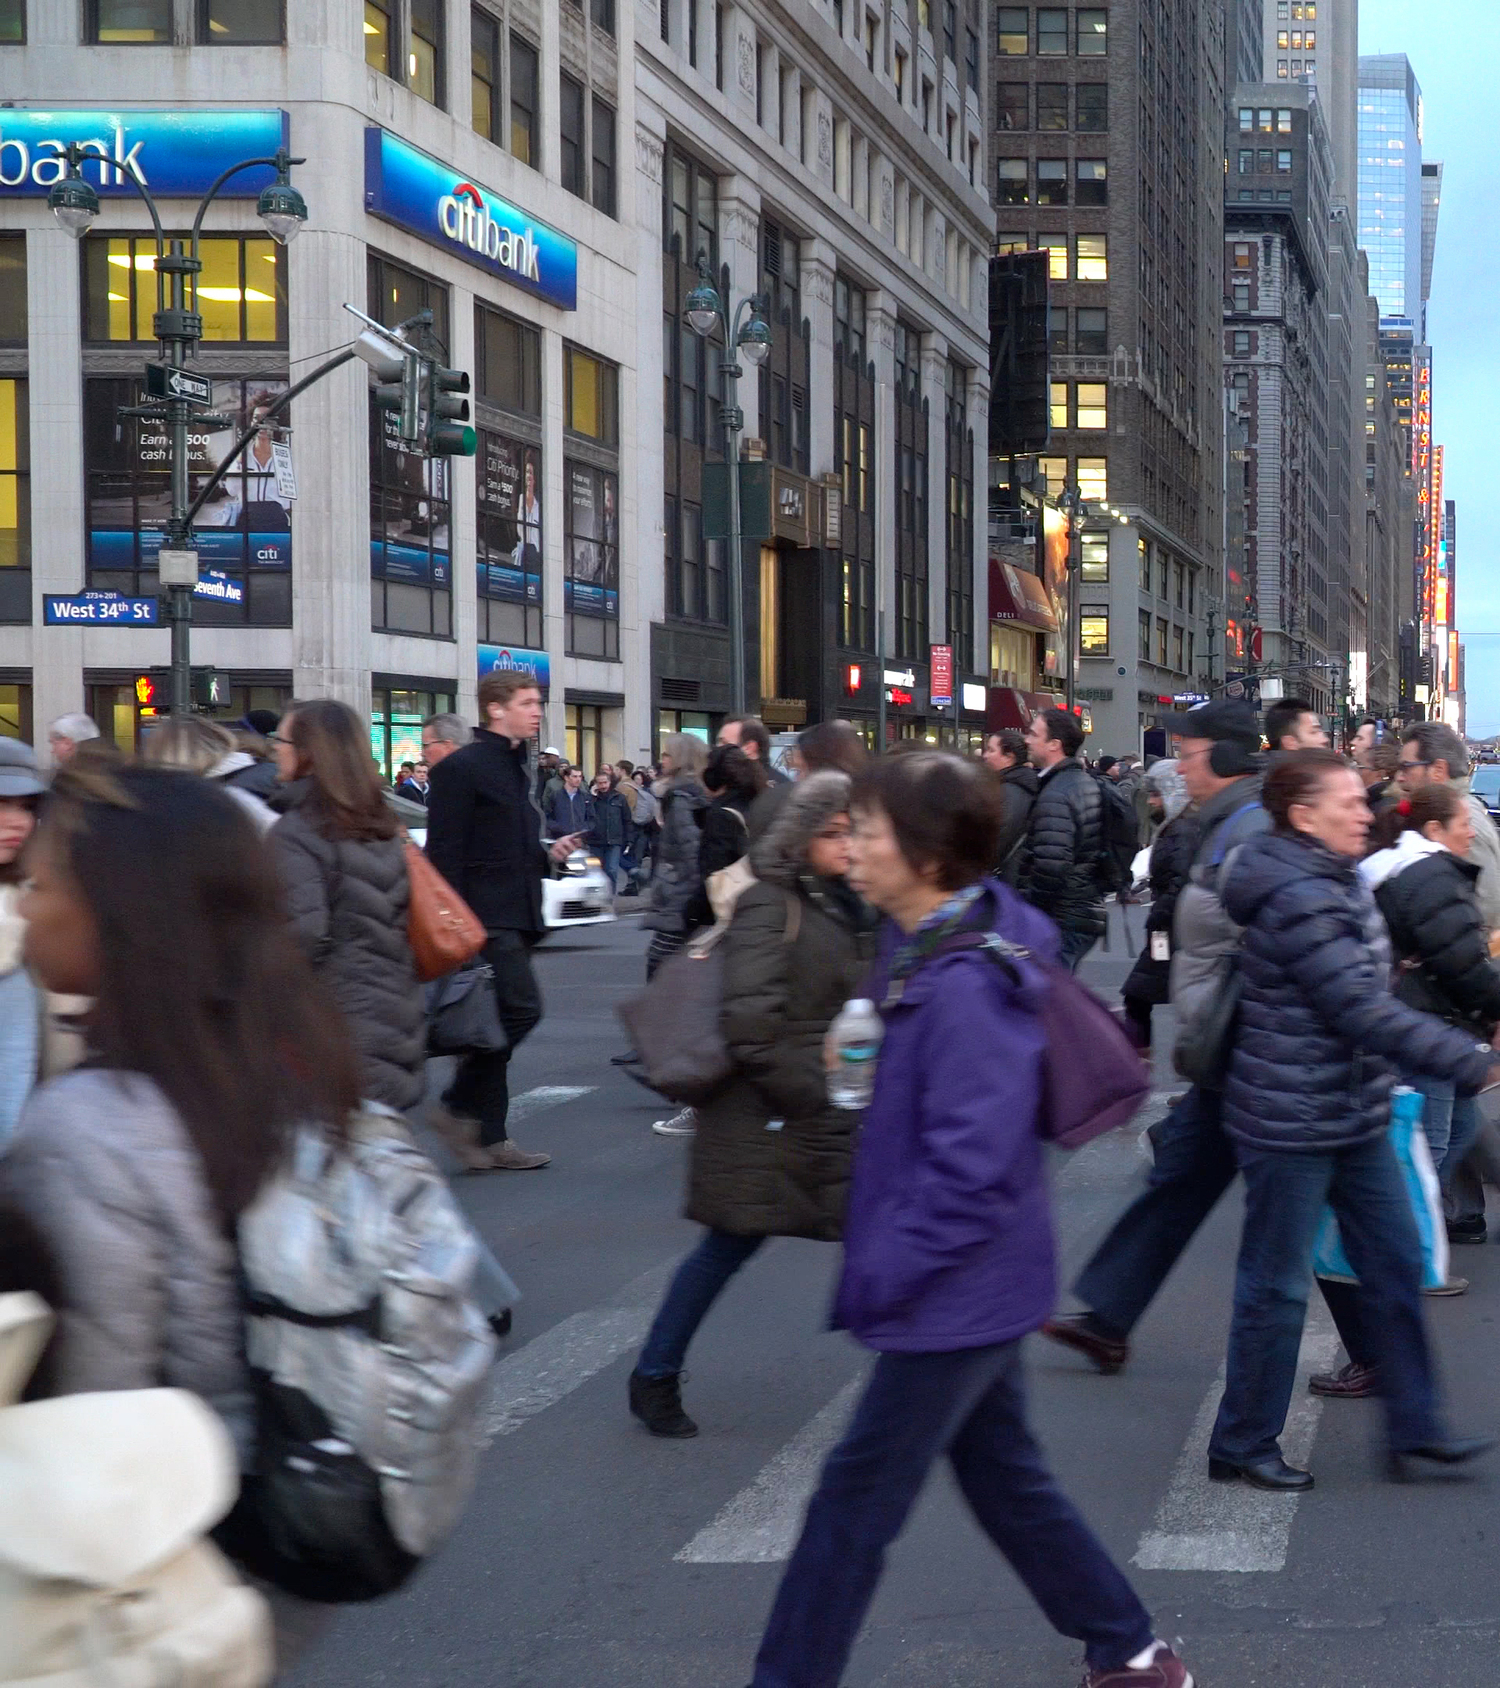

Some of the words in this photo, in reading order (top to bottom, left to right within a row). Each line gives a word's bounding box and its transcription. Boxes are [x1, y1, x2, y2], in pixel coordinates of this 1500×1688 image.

[0, 125, 148, 186] bank
[438, 190, 540, 282] citibank
[1419, 368, 1430, 467] ERNST
[140, 434, 166, 445] Earn
[186, 434, 210, 445] 500
[140, 450, 166, 460] cash
[257, 547, 277, 560] citi
[225, 584, 242, 600] Ave
[52, 602, 95, 618] West
[99, 601, 129, 618] 34th
[133, 602, 150, 618] St
[996, 611, 1015, 619] DELI
